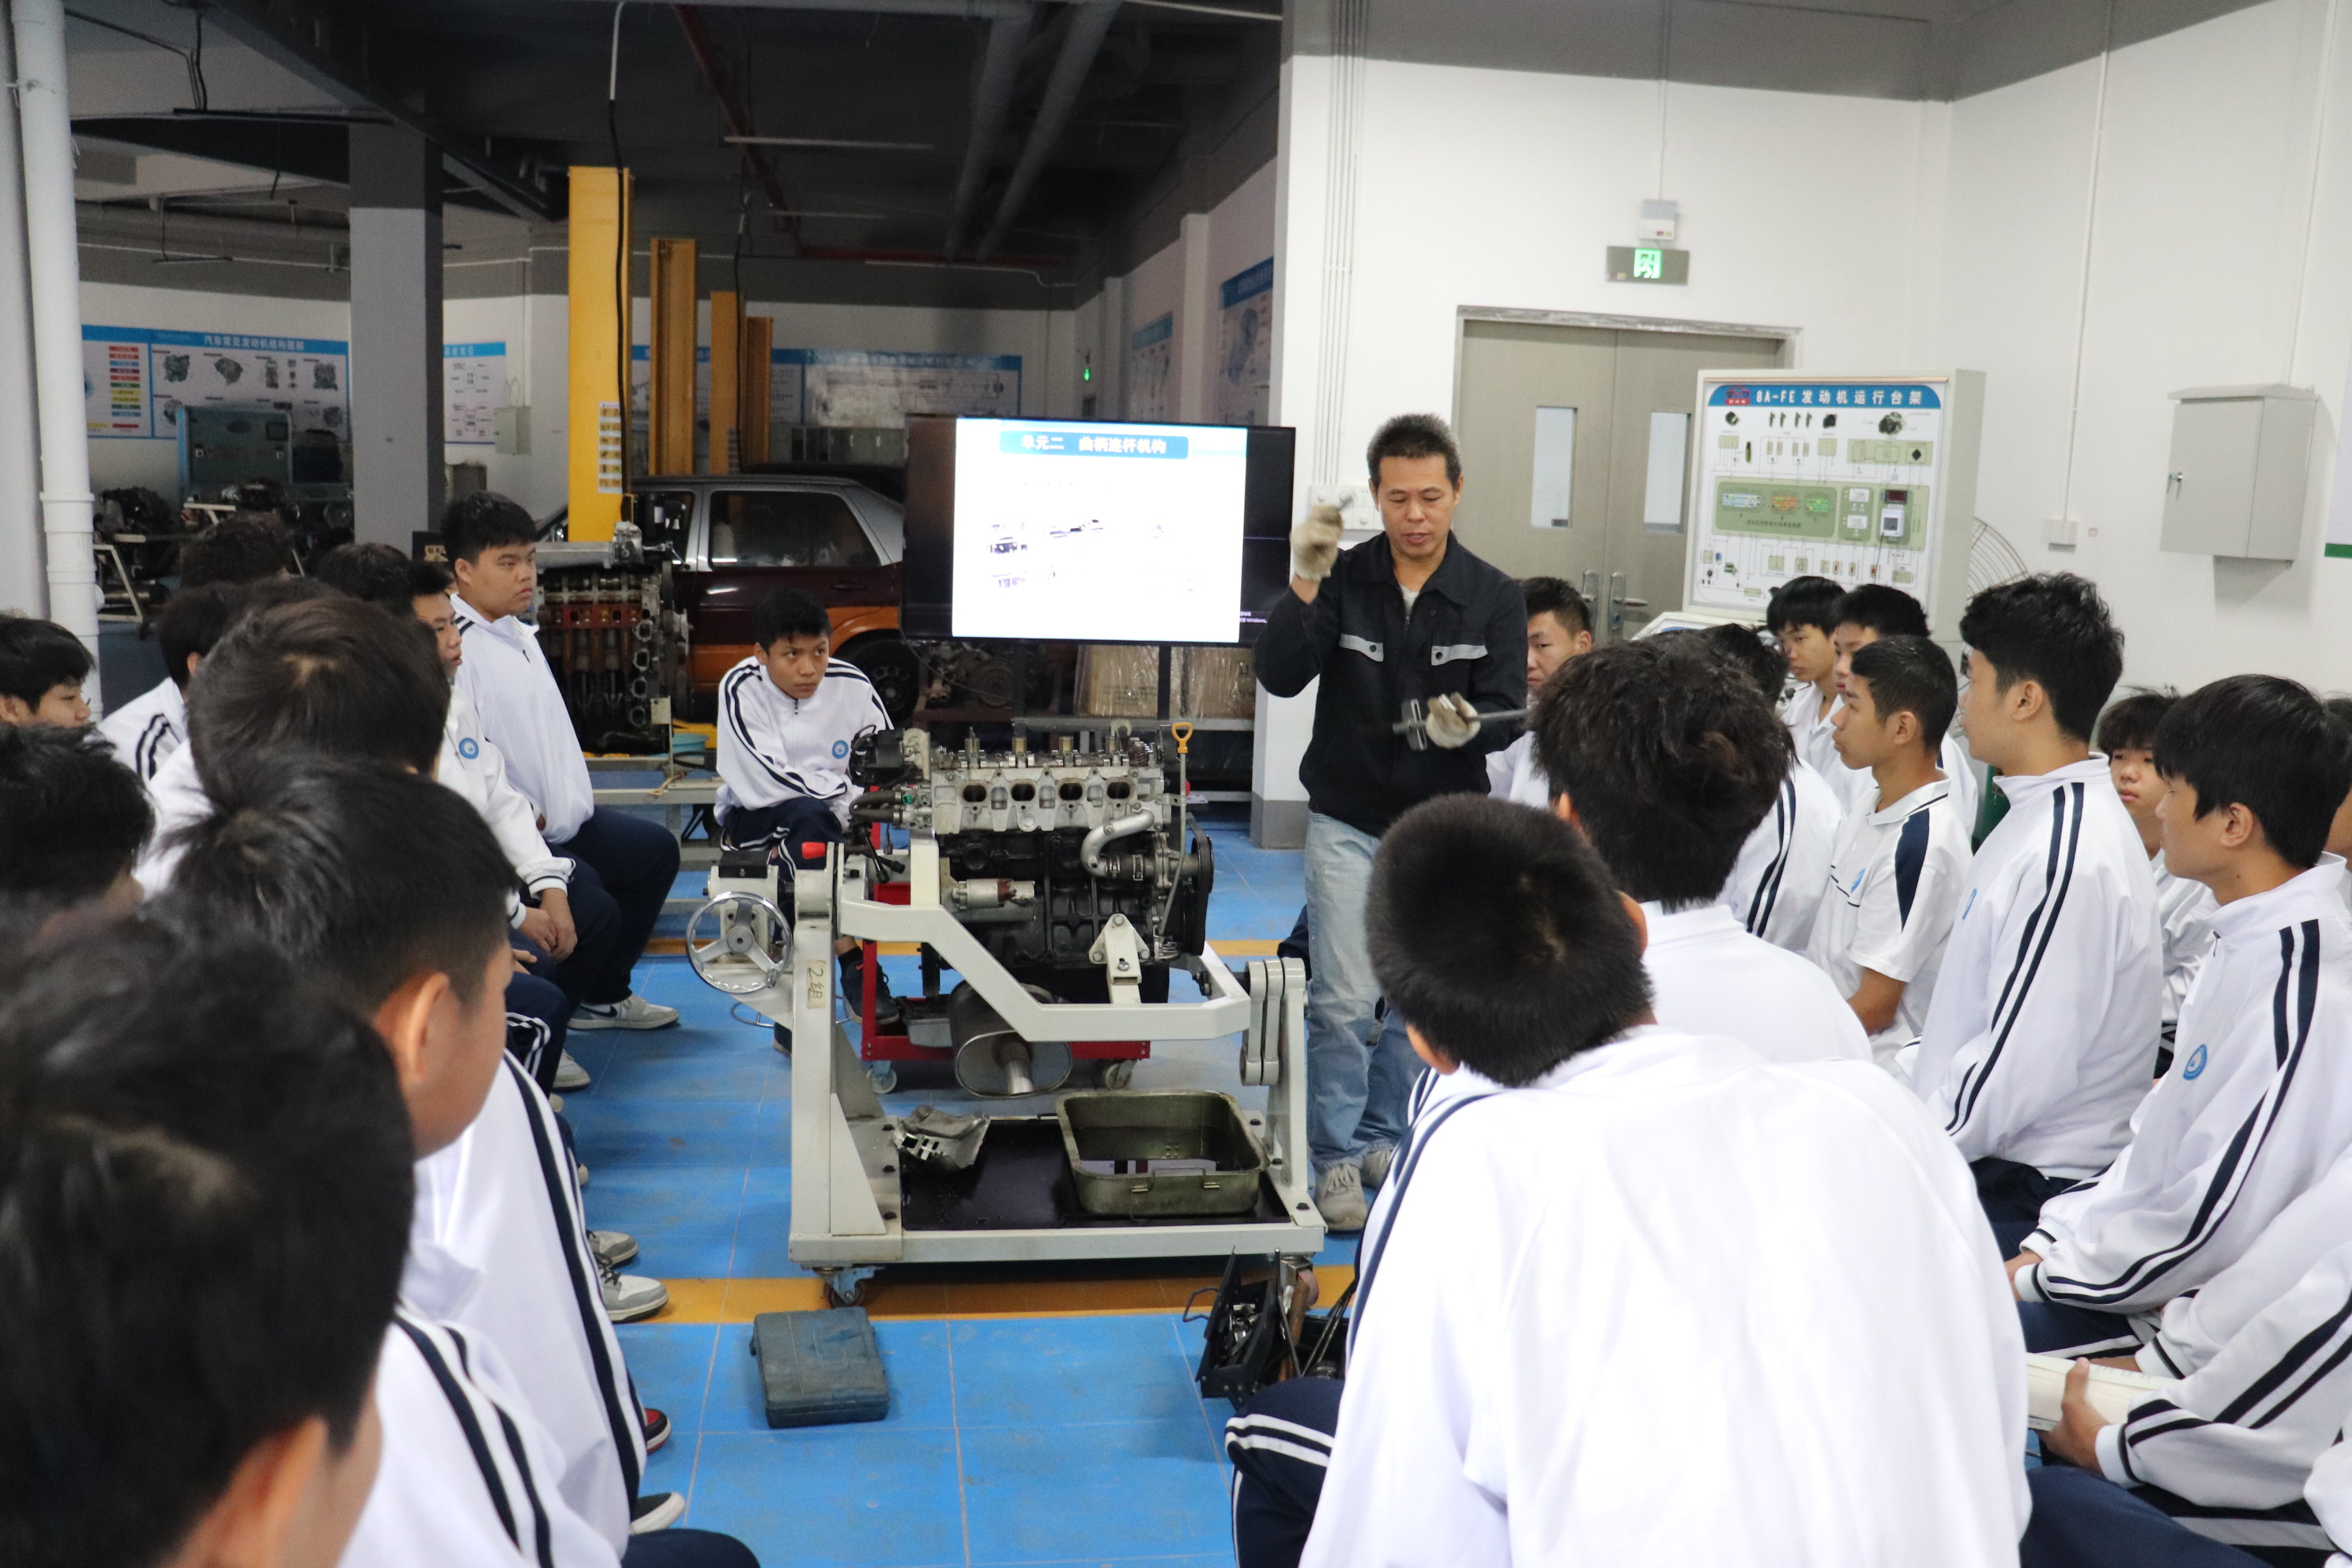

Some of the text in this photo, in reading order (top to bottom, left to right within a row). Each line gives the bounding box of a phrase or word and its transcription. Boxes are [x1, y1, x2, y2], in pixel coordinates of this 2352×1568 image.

[1020, 434, 1167, 454] 单元二 曲柄连杆机构
[808, 967, 825, 1002] 2组
